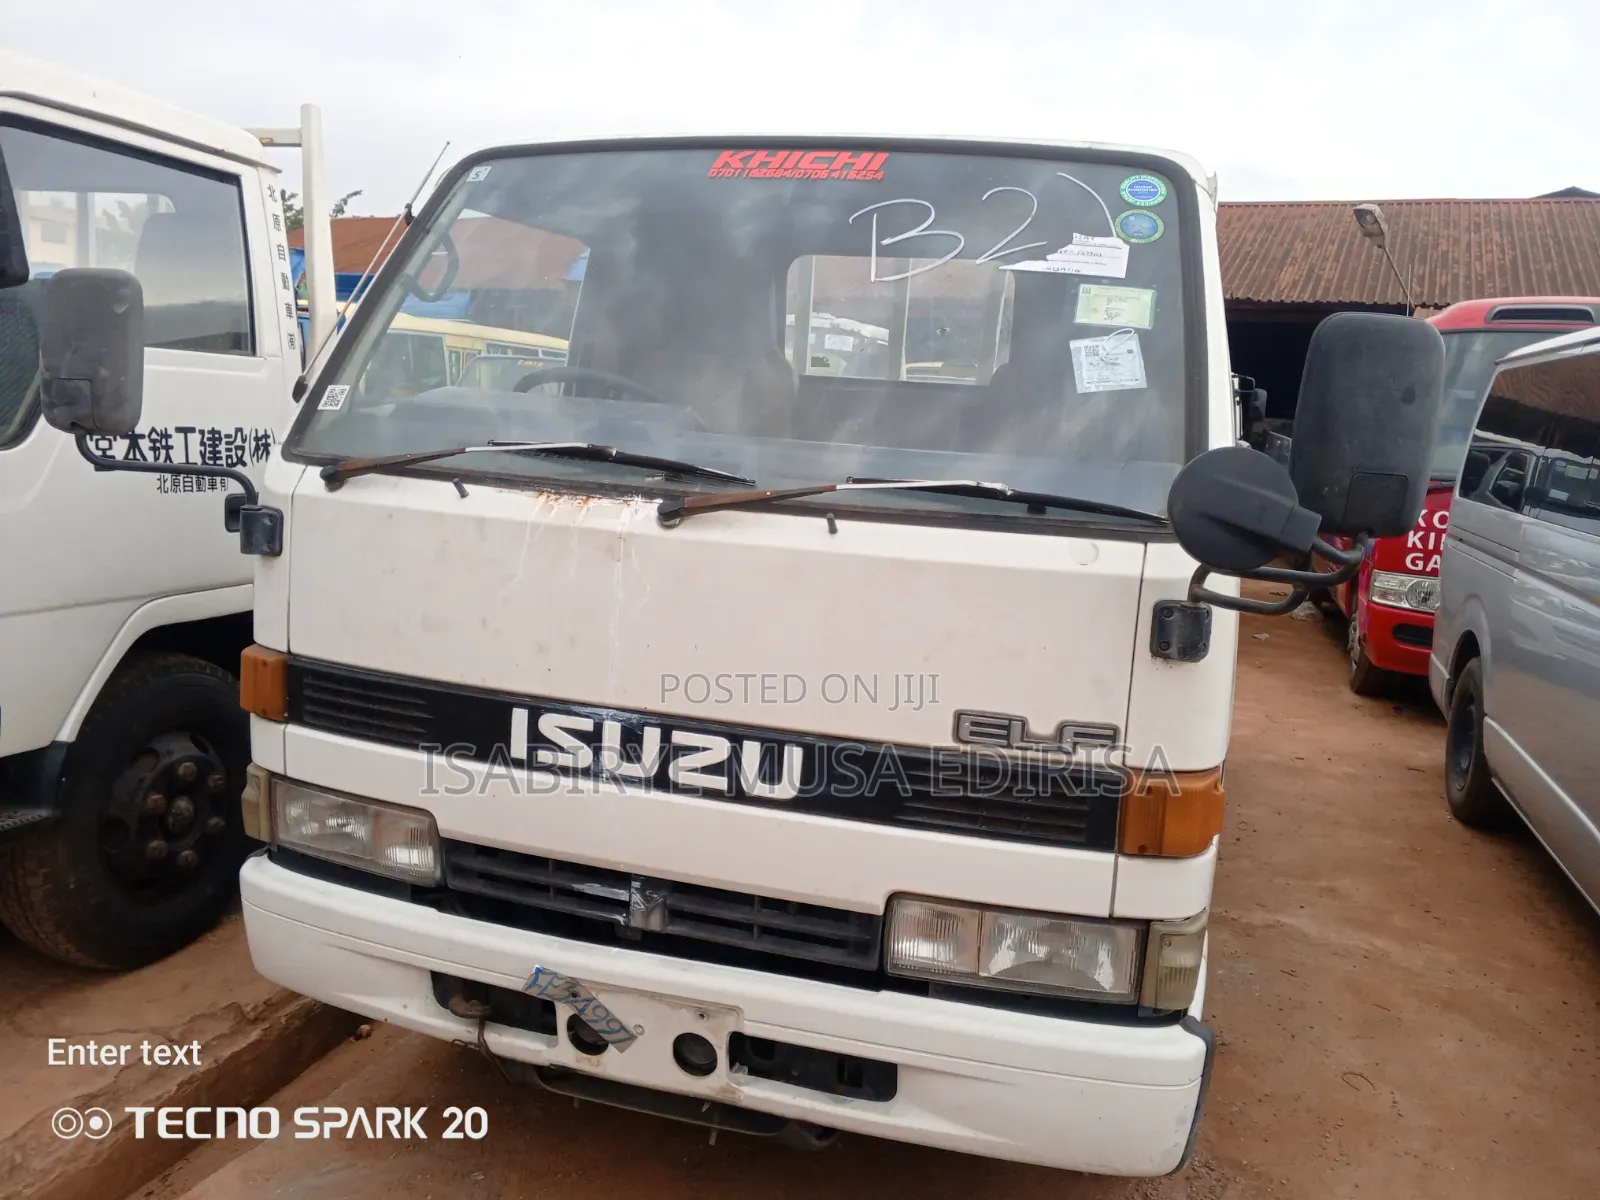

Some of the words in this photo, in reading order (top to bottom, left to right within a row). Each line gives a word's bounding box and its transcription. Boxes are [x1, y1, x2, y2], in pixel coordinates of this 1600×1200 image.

[711, 150, 890, 171] KHICHI
[510, 706, 804, 801] ISUZU
[956, 712, 1118, 756] ELF
